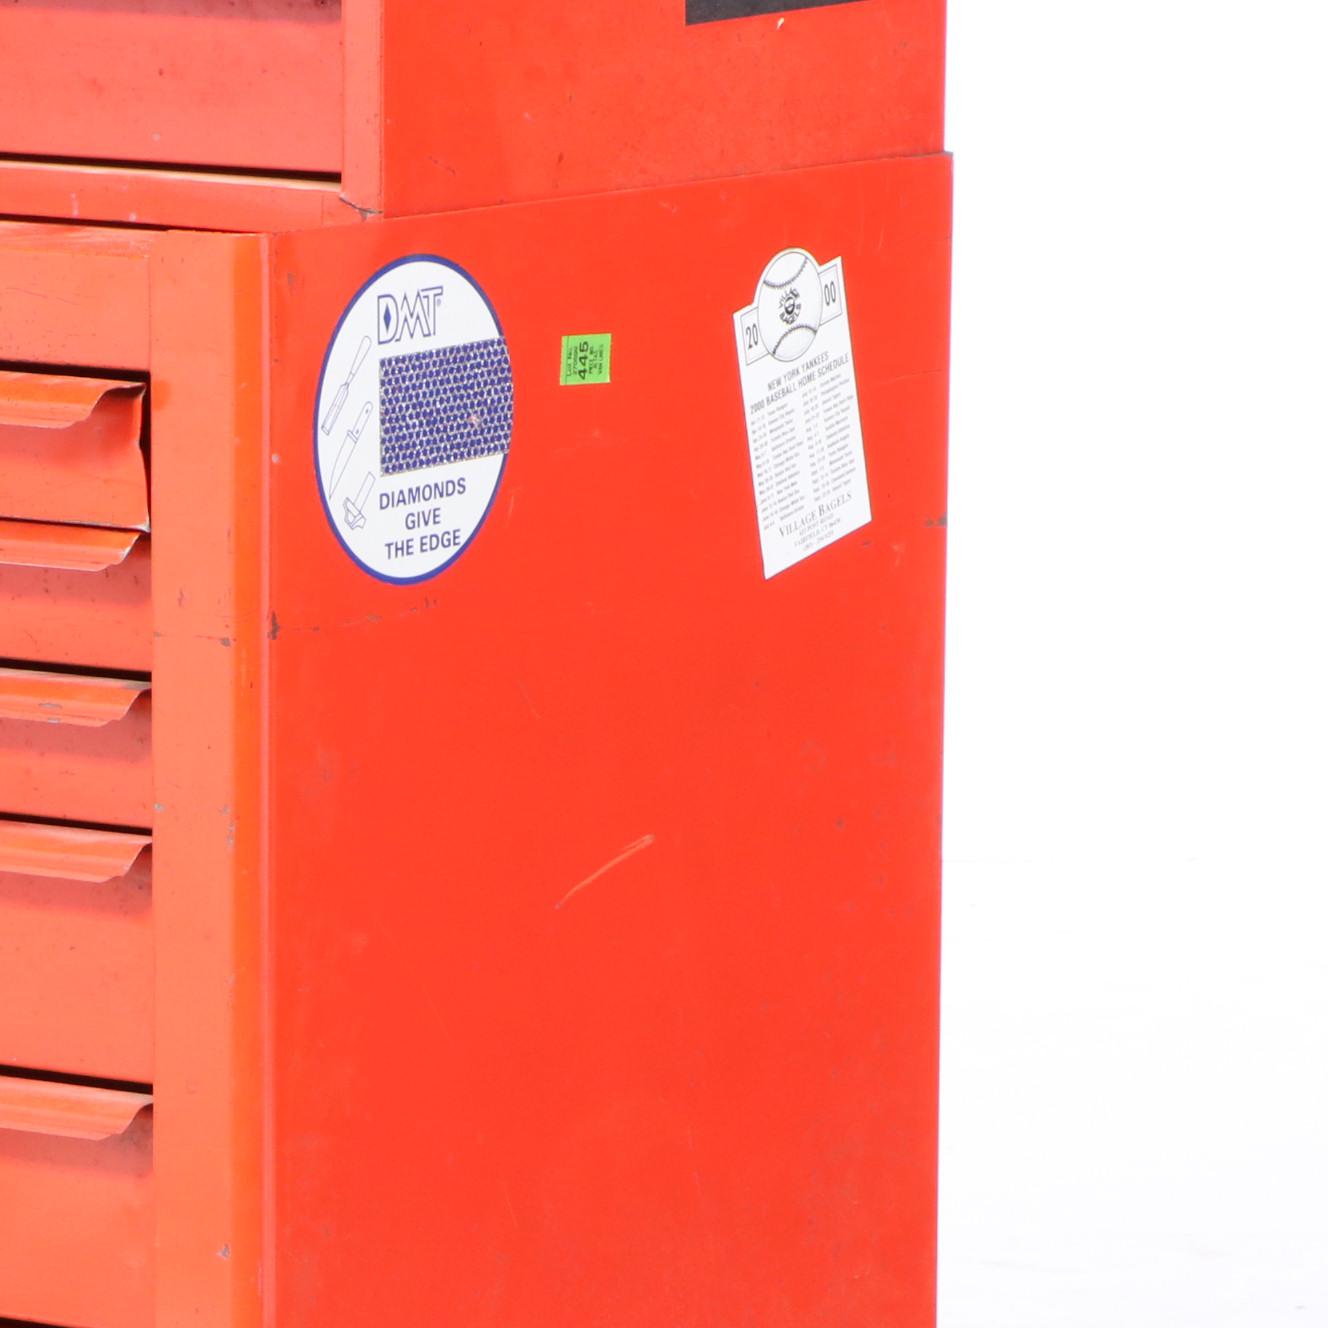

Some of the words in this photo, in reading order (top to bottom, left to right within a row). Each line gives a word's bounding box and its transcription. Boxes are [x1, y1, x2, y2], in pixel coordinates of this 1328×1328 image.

[824, 281, 836, 306] 00
[377, 286, 443, 345] DMT
[746, 323, 758, 349] 20
[578, 341, 588, 380] 445
[767, 375, 782, 391] NEW
[783, 368, 800, 384] YORK
[801, 350, 830, 372] YANKEES
[766, 382, 797, 408] BASEBALL
[798, 372, 816, 389] HOME
[817, 352, 849, 378] SCHEDULE
[379, 477, 467, 511] DIAMONDS
[404, 507, 441, 530] GIVE
[778, 510, 817, 538] VILLAGE
[818, 491, 853, 517] BAGELS
[385, 538, 414, 560] THE
[419, 528, 461, 553] EDGE
